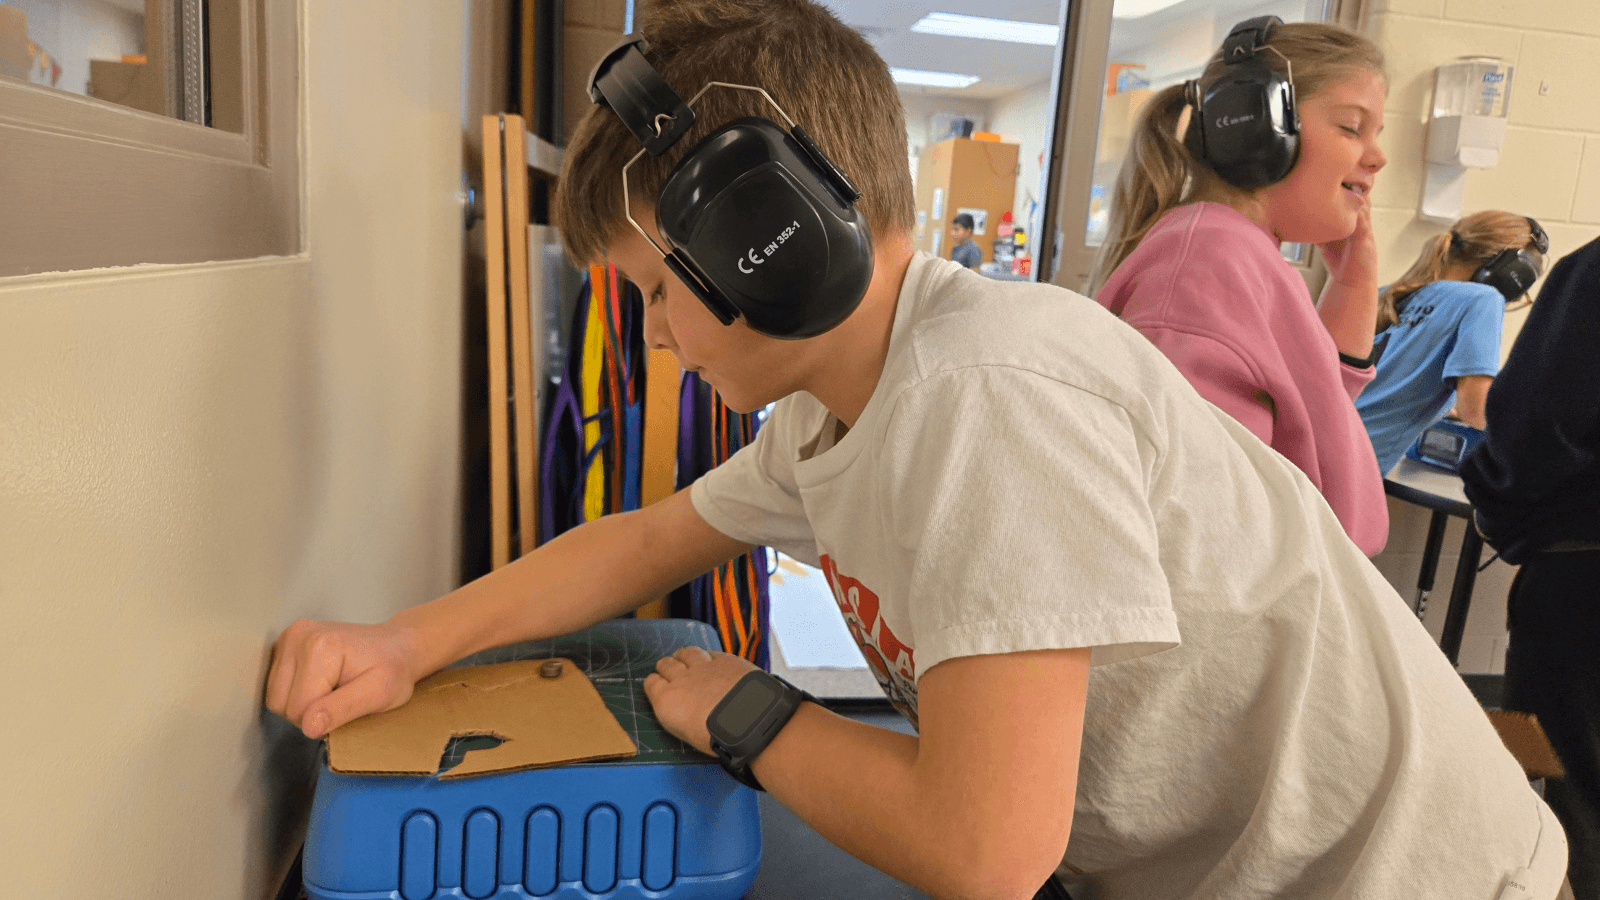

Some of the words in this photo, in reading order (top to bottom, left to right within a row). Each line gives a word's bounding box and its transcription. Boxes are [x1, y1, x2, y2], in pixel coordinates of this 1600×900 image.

[737, 247, 765, 274] CE
[763, 241, 779, 257] EN
[776, 220, 801, 245] 352-1
